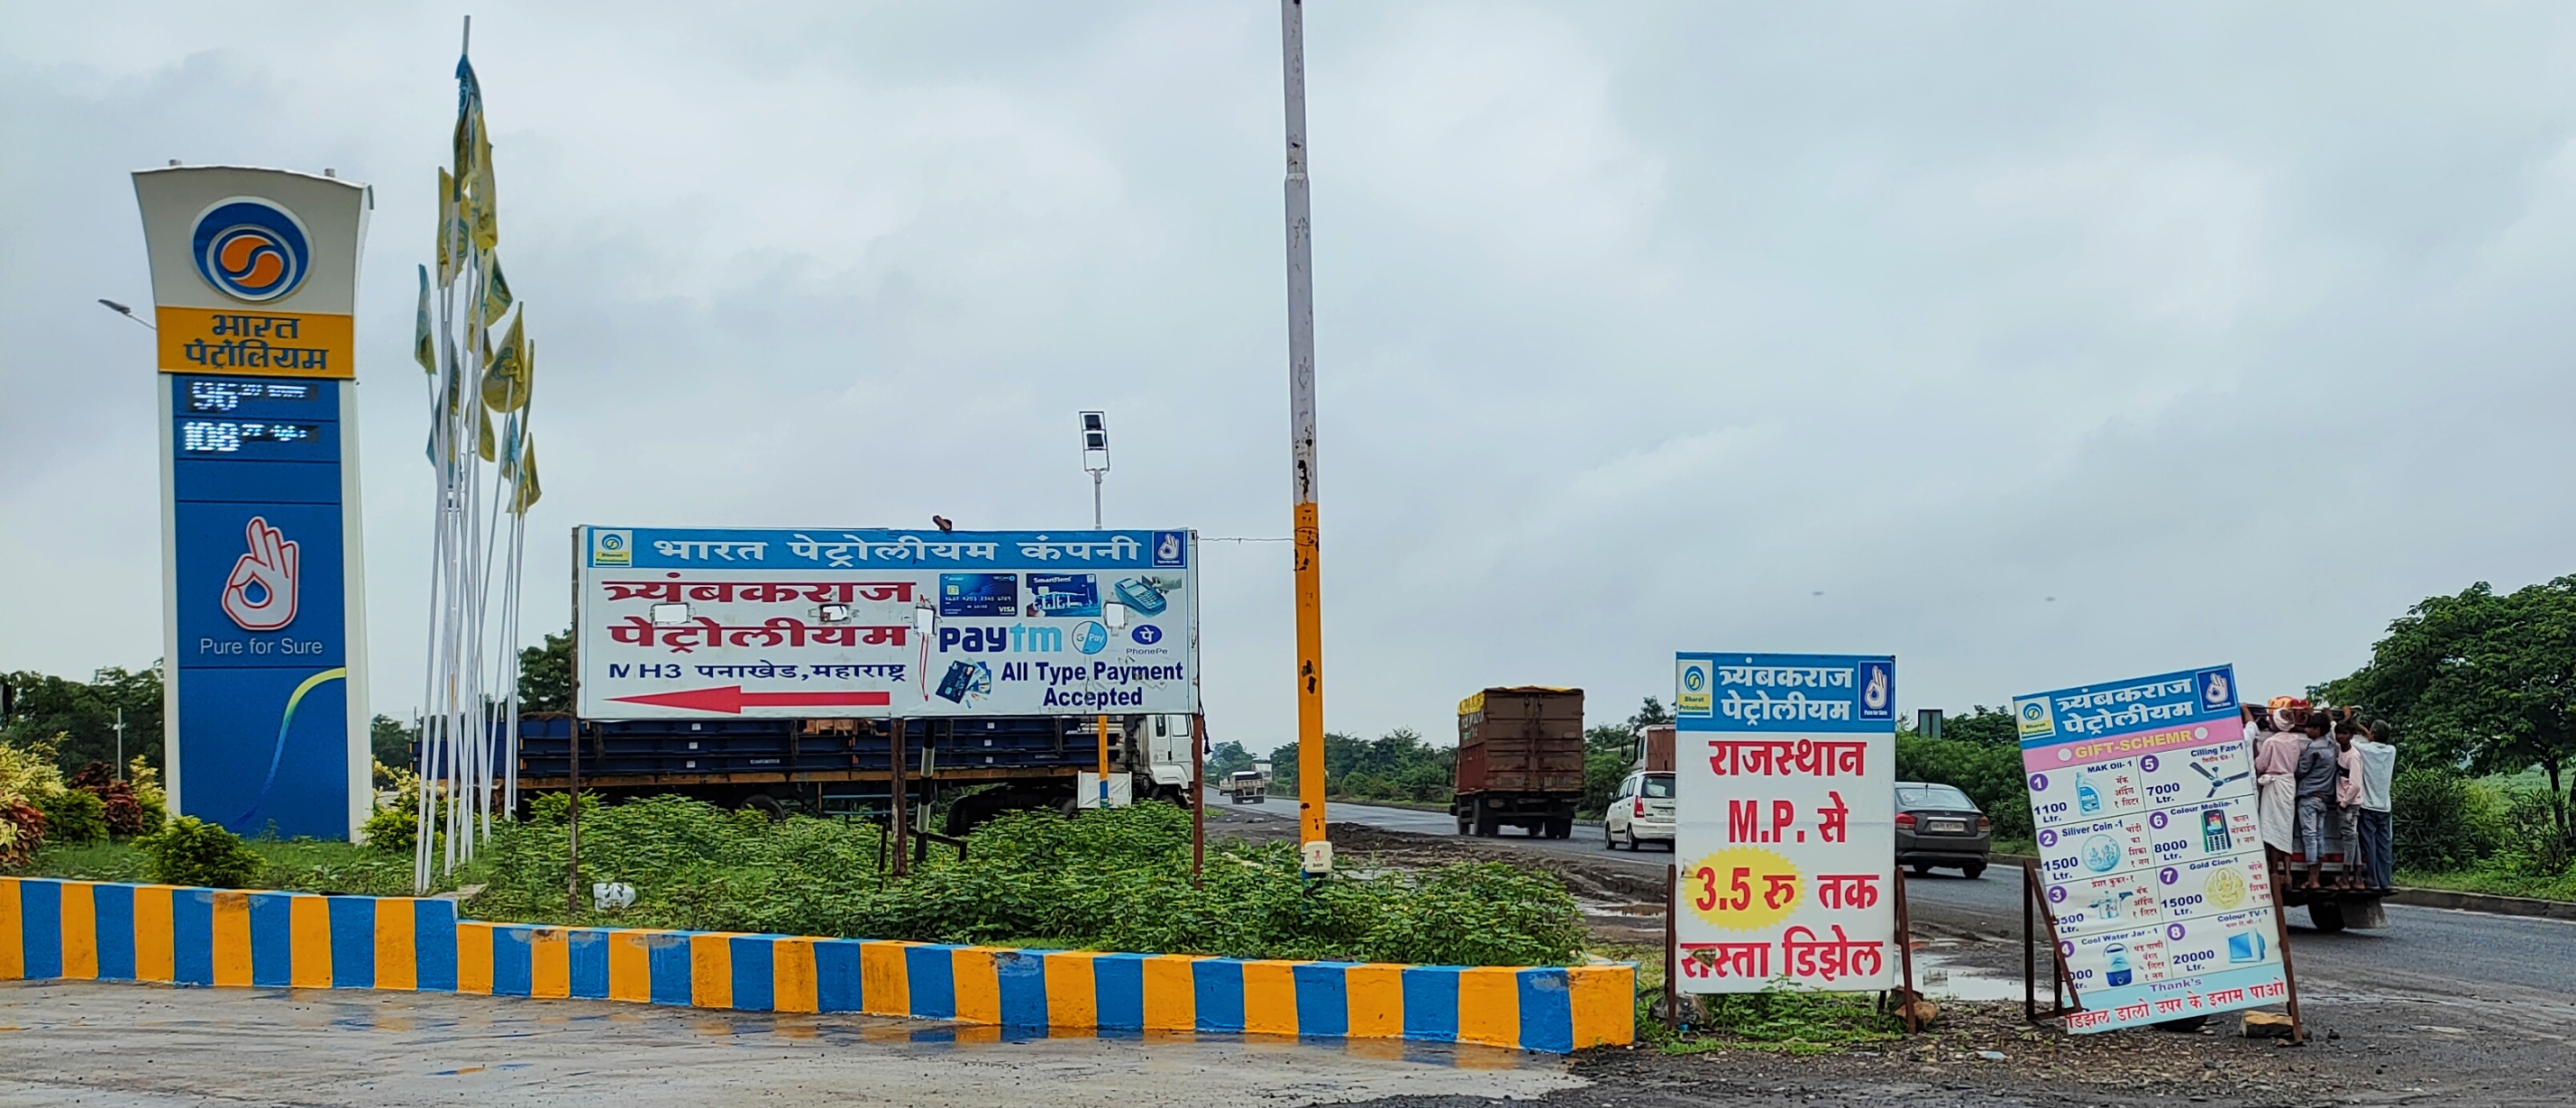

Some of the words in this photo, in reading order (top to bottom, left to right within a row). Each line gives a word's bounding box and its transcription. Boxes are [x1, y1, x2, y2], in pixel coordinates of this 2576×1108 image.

[211, 315, 301, 340] भारत
[183, 337, 329, 371] पेट्रोलियम
[653, 539, 769, 562] भारत
[786, 534, 1000, 568] पेट्रोलीयम
[1017, 535, 1143, 562] कंपनी
[607, 617, 912, 654] पेट्रोलीयम
[1089, 634, 1104, 643] Pay
[1139, 627, 1155, 643] पे
[200, 637, 242, 655] Pure
[250, 637, 274, 655] for
[281, 637, 324, 655] Sure
[1001, 663, 1028, 682] All
[1035, 662, 1086, 685] Type
[1093, 662, 1183, 685] Payment
[1043, 687, 1143, 710] Accepted
[1721, 690, 1852, 727] पेट्रोलीयम
[2062, 701, 2194, 735] पेट्रोलीयम
[2075, 729, 2193, 758] GIFT-SCHEMR
[1708, 738, 1868, 777] राजस्थान
[2145, 758, 2154, 770] 5
[2087, 764, 2108, 774] MAK
[2033, 777, 2042, 789] 1
[2146, 783, 2180, 796] 7000
[2033, 801, 2068, 815] 1100
[2170, 805, 2198, 816] Colour
[1728, 800, 1805, 844] M.P.
[1817, 791, 1849, 844] से
[2153, 815, 2163, 827] 6
[2061, 826, 2090, 838] Siliver
[2092, 821, 2114, 832] Coin
[2043, 833, 2053, 845] 2
[2154, 839, 2188, 853] 8000
[2043, 856, 2078, 872] 1500
[2189, 861, 2209, 870] Gold
[2163, 870, 2173, 883] 7
[1695, 866, 1751, 911] 3.5
[1762, 874, 1796, 911] रु
[1816, 874, 1880, 910] तक
[2051, 889, 2062, 901] 3
[2160, 893, 2203, 909] 15000
[2217, 912, 2245, 922] Colour
[2081, 937, 2100, 946] Cool
[2103, 933, 2129, 942] Water
[2131, 929, 2145, 938] Jar
[2170, 926, 2181, 937] 8
[1781, 925, 1884, 982] डिझेल
[2061, 943, 2070, 956] 4
[2172, 949, 2215, 965] 20000
[2063, 968, 2093, 982] 000
[2150, 978, 2202, 992] Thank's
[2115, 998, 2150, 1021] डालो
[2154, 998, 2183, 1014] उपर
[2187, 990, 2203, 1009] के
[2206, 989, 2244, 1009] इनाम
[2249, 976, 2285, 999] पाओ
